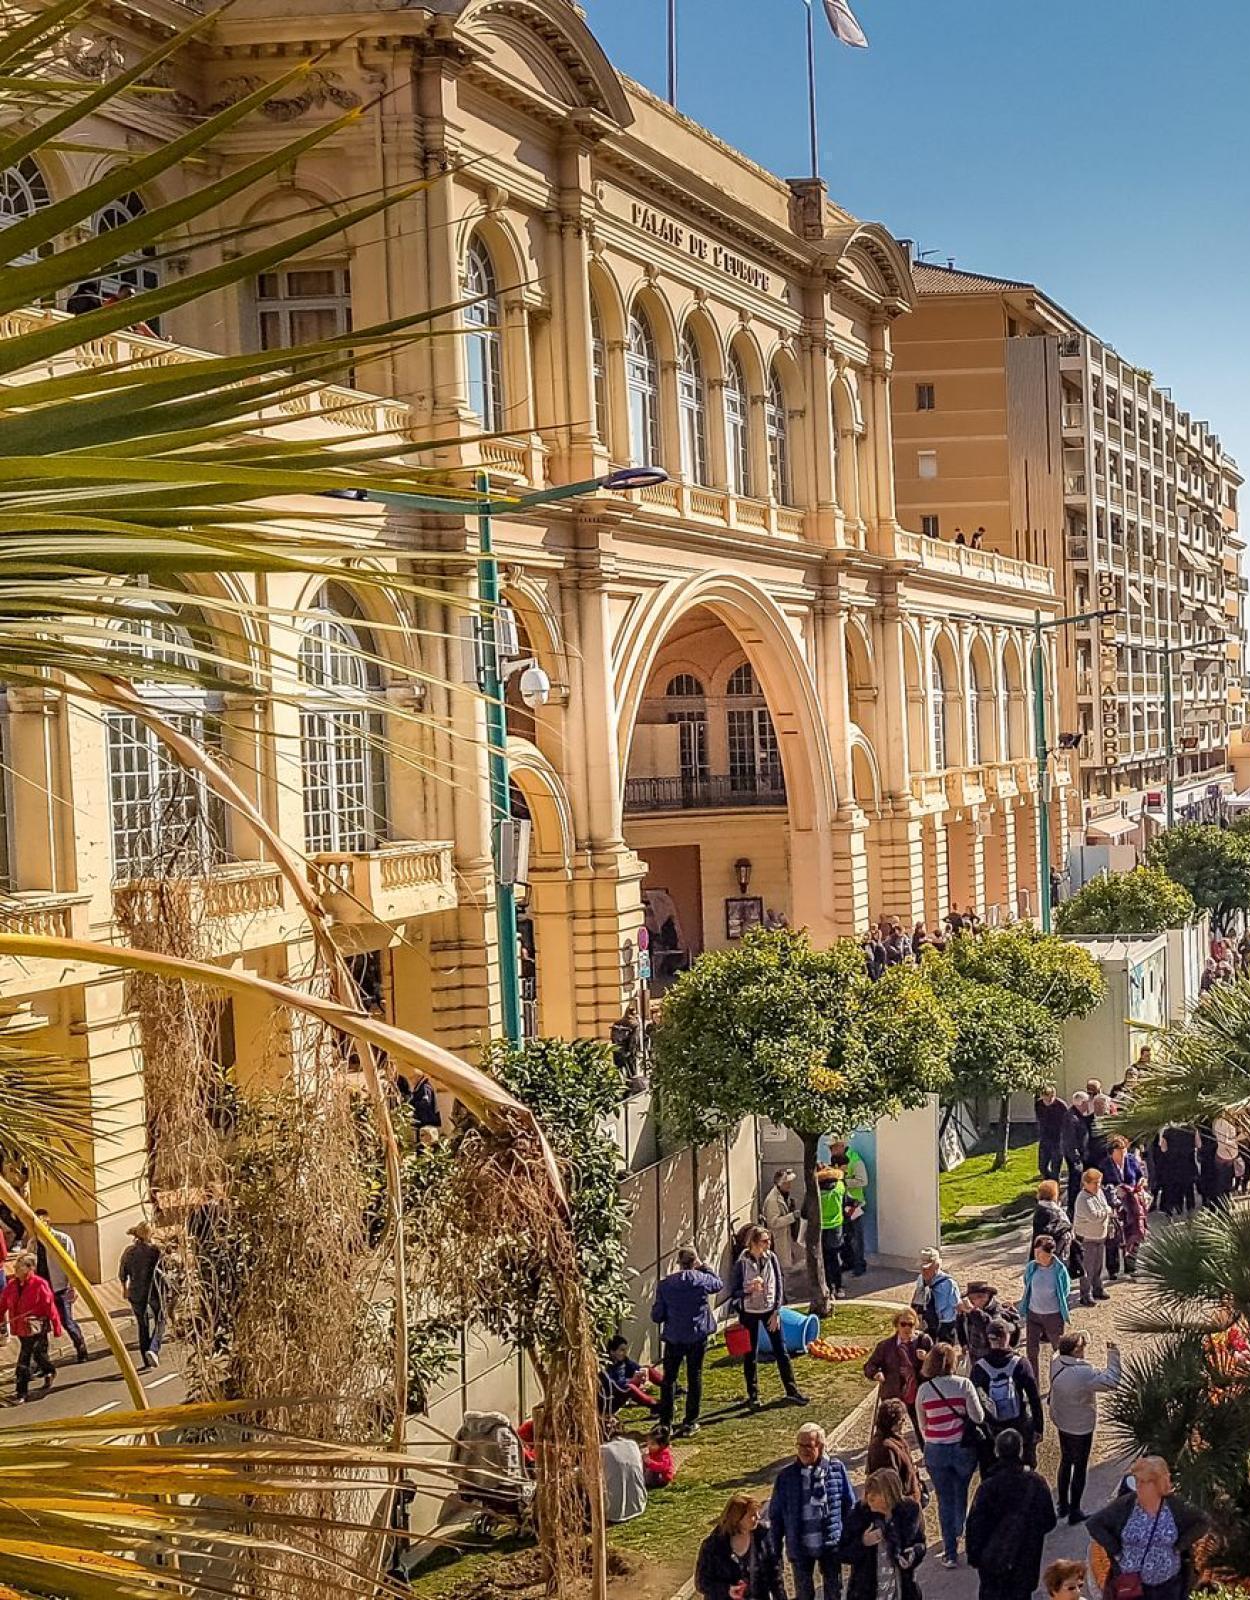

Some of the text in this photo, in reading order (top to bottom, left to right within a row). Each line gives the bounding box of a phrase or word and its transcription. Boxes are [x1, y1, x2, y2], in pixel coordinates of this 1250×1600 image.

[631, 202, 770, 292] PALAIS DE L'EUROPE
[1099, 572, 1118, 766] HOTEL CAMBORD
